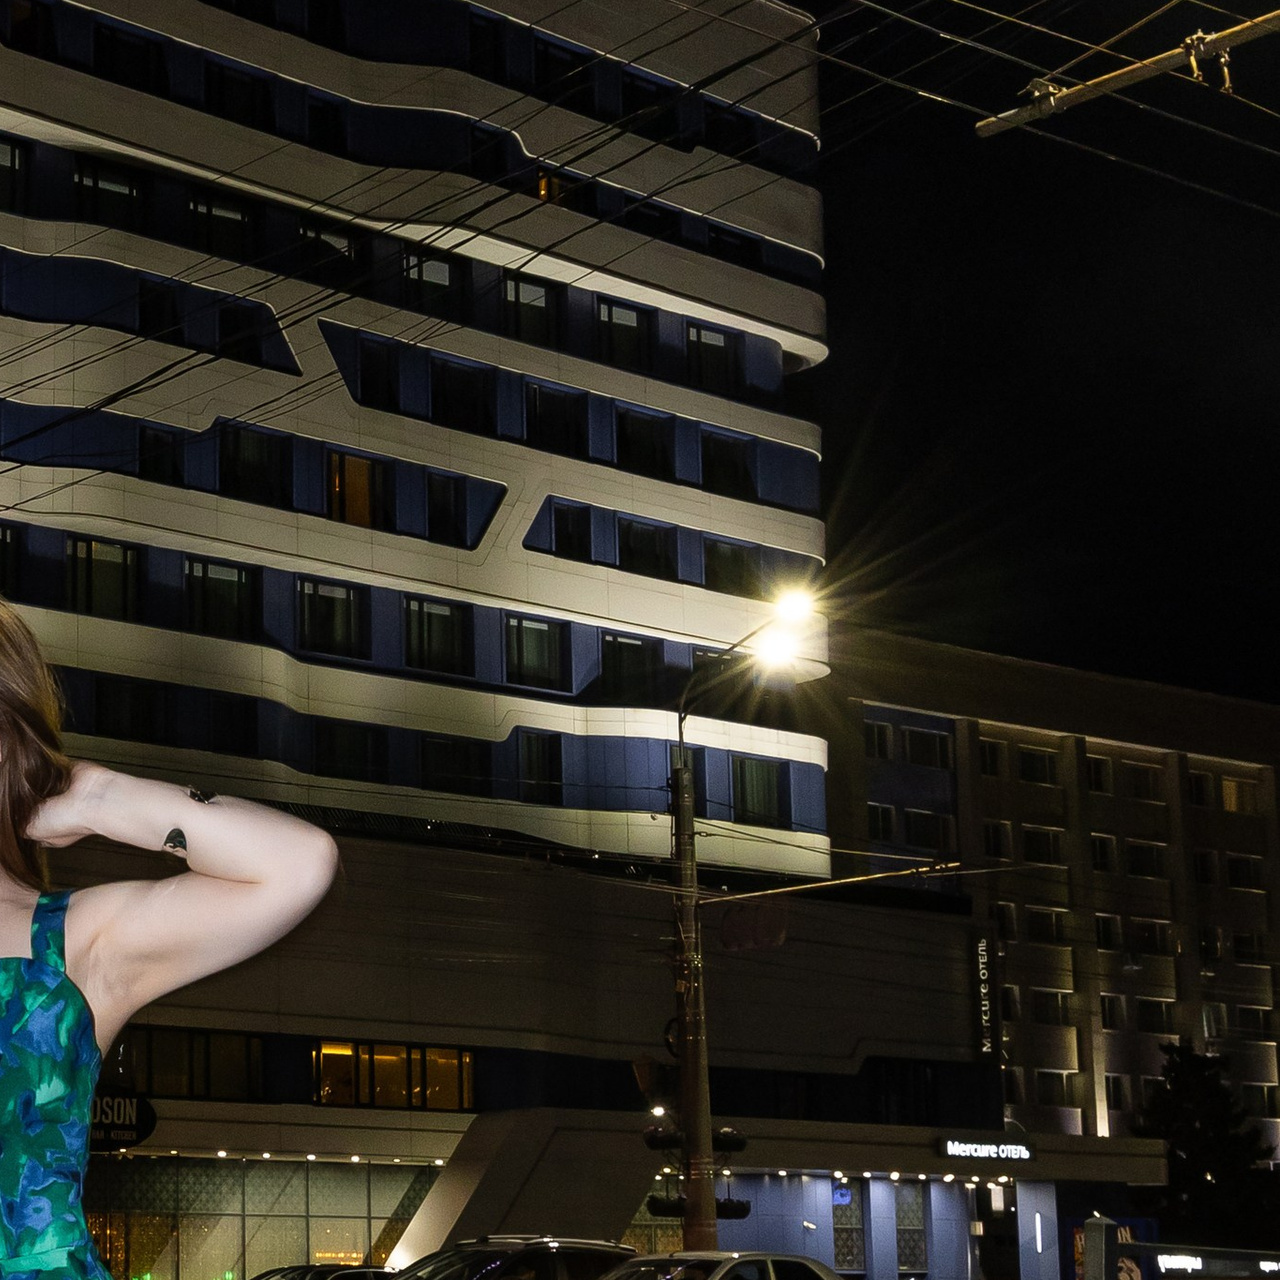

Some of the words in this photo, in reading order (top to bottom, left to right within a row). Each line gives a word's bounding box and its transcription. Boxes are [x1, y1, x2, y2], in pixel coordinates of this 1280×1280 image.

[978, 938, 989, 980] ОТЕЛЬ
[980, 983, 992, 1053] Mercure
[91, 1096, 137, 1125] DSON
[946, 1140, 998, 1158] Mercure
[999, 1144, 1030, 1159] ОТЕЛЬ
